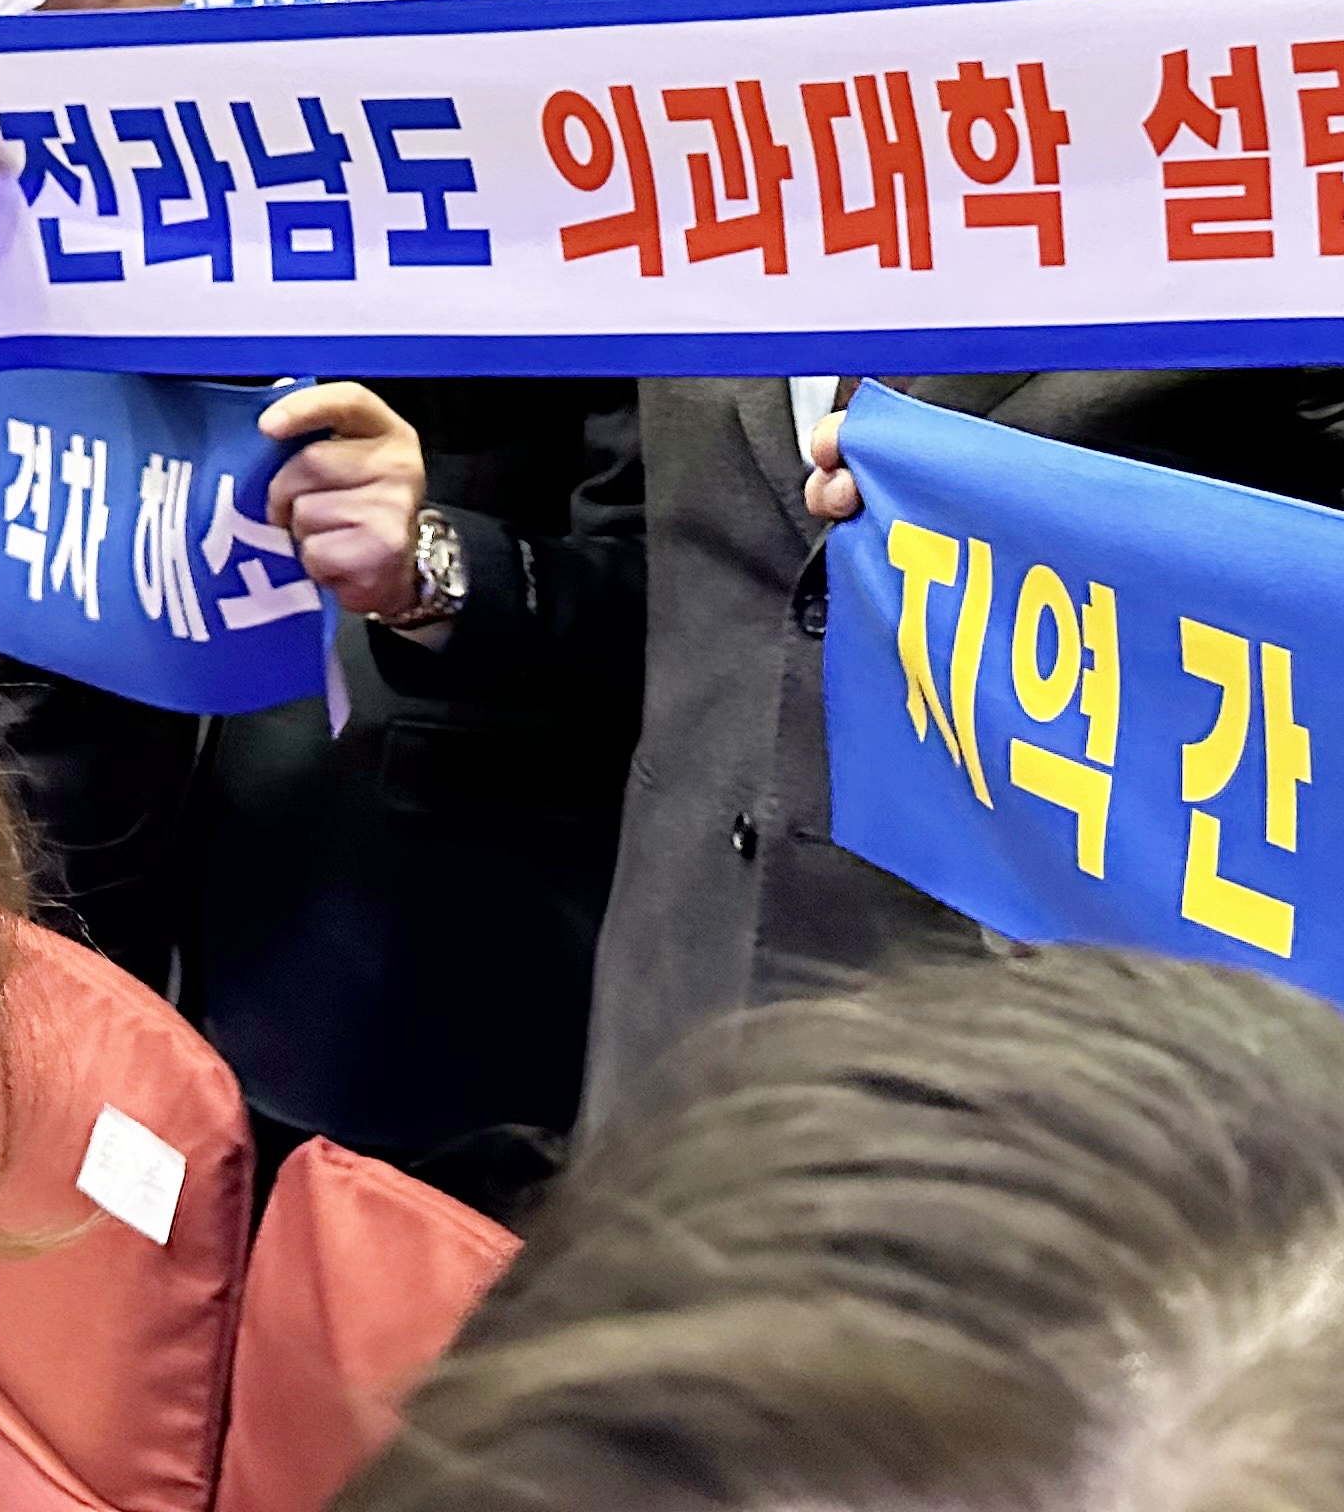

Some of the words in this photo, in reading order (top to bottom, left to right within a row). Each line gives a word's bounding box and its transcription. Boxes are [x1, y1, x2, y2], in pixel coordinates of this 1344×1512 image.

[541, 61, 1071, 277] 의과대학
[134, 453, 323, 642] 해소
[887, 519, 1120, 880] 지역
[1180, 617, 1312, 958] 간
